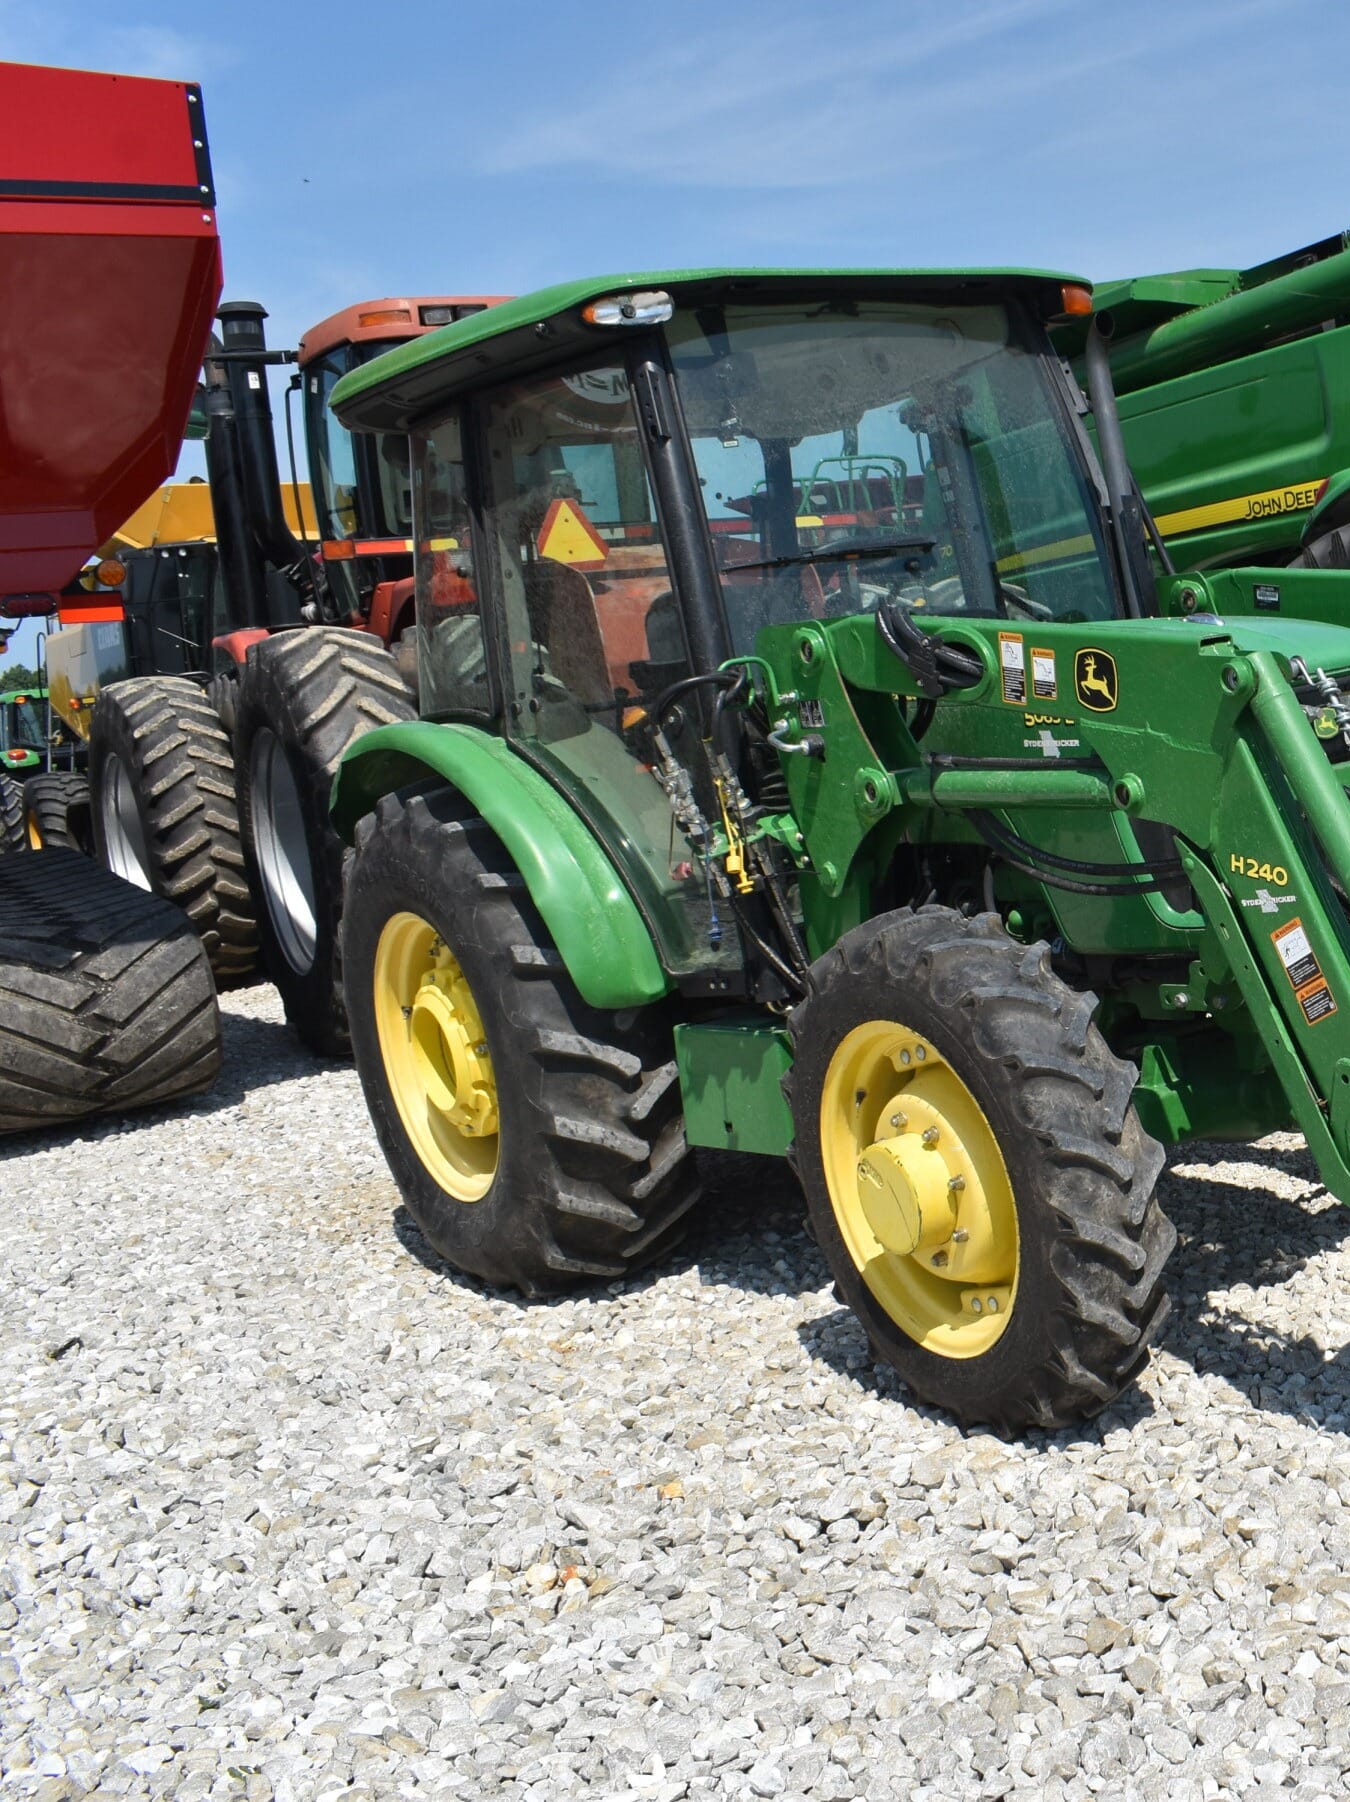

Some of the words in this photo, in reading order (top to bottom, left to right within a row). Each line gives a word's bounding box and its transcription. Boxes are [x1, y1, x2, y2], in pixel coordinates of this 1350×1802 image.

[1245, 496, 1282, 519] JOHN
[1284, 488, 1319, 508] DEE
[1230, 853, 1289, 887] H240
